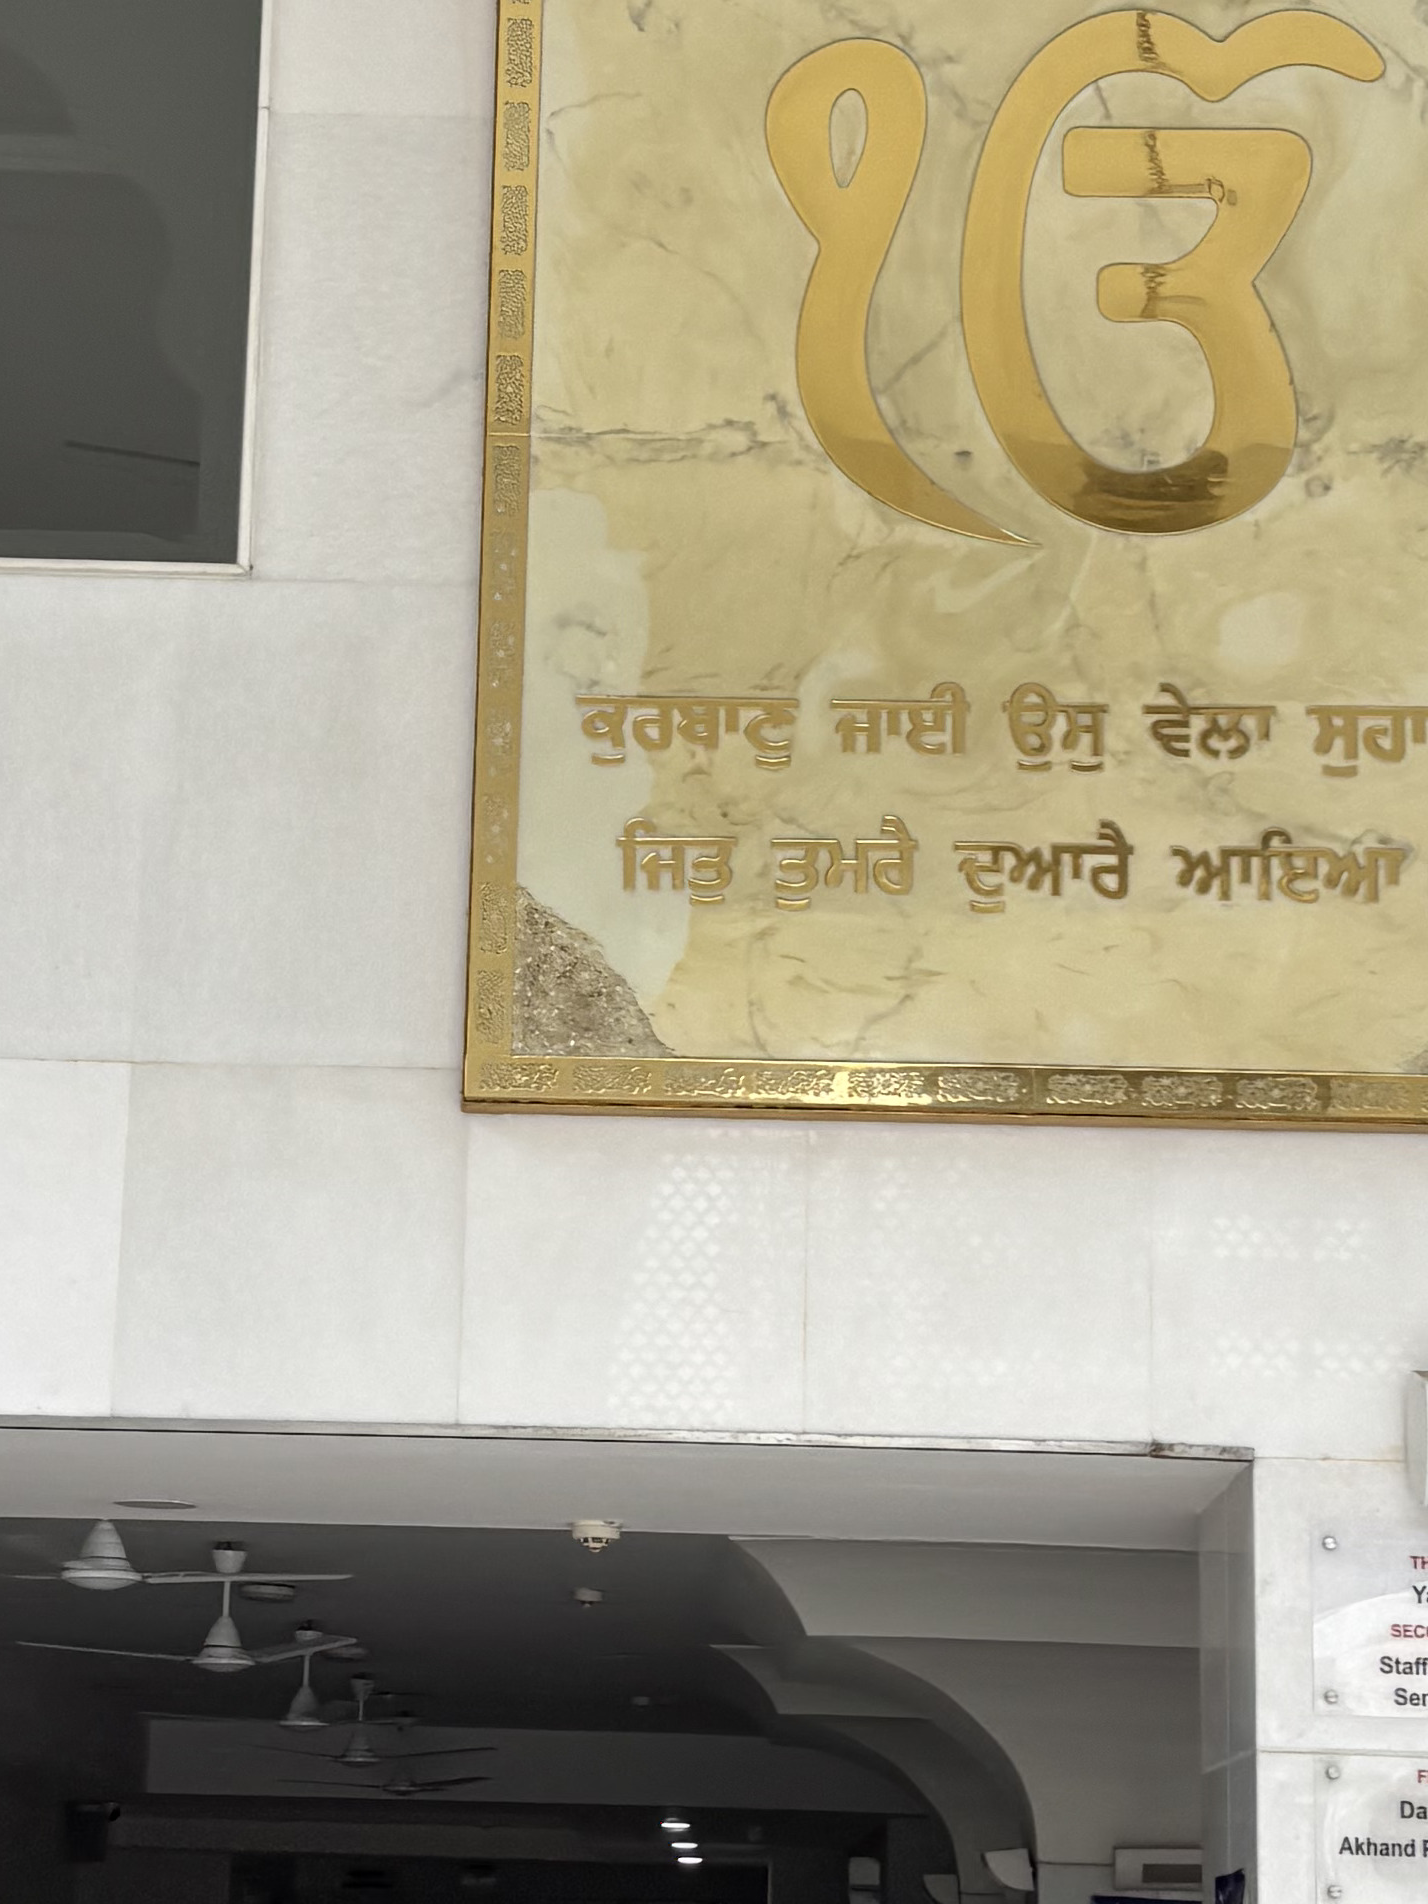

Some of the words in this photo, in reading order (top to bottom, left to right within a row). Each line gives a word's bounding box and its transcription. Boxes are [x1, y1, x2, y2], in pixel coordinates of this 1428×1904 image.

[575, 694, 799, 770] ਕੁਰਬਾਣੁ
[830, 682, 970, 755] ਜਾਈ
[1003, 682, 1109, 773] ਉਸੁ
[1142, 682, 1277, 760] ਵੇਲਾ
[616, 816, 738, 906] ਜਿਤੁ
[770, 814, 919, 911] ਤੁਮਰੈ
[954, 819, 1134, 913] ਦੁਆਰੈ
[1170, 827, 1408, 904] ਆਇਆ
[1380, 1656, 1428, 1675] Staff
[1339, 1837, 1415, 1857] Akhand
